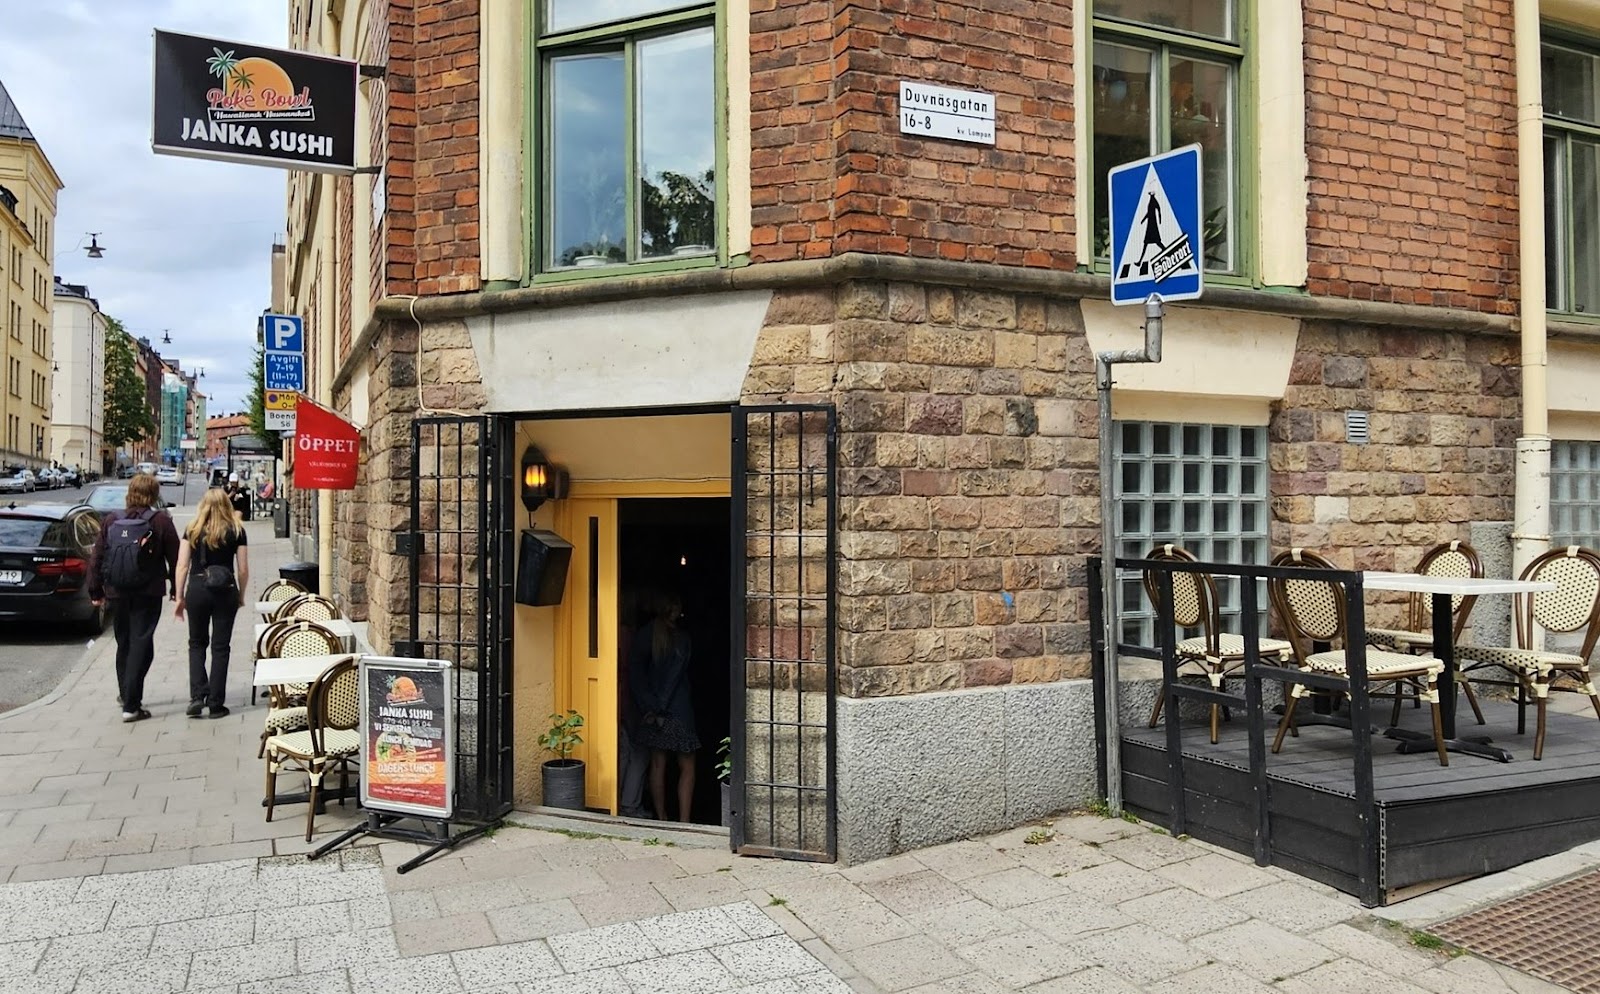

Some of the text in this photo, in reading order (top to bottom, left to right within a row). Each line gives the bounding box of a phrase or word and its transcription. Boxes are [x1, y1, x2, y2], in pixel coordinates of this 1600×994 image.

[206, 86, 312, 109] Poké Bowl
[905, 88, 988, 113] Duvnäsgatan
[904, 113, 932, 130] 16-8
[181, 117, 333, 157] JANKA SUSHI
[1153, 241, 1191, 278] Söderort
[274, 318, 297, 349] P
[270, 355, 299, 364] Avgift
[272, 372, 297, 380] (11-17)
[299, 434, 356, 452] ÖPPET
[409, 709, 433, 720] SUSHI
